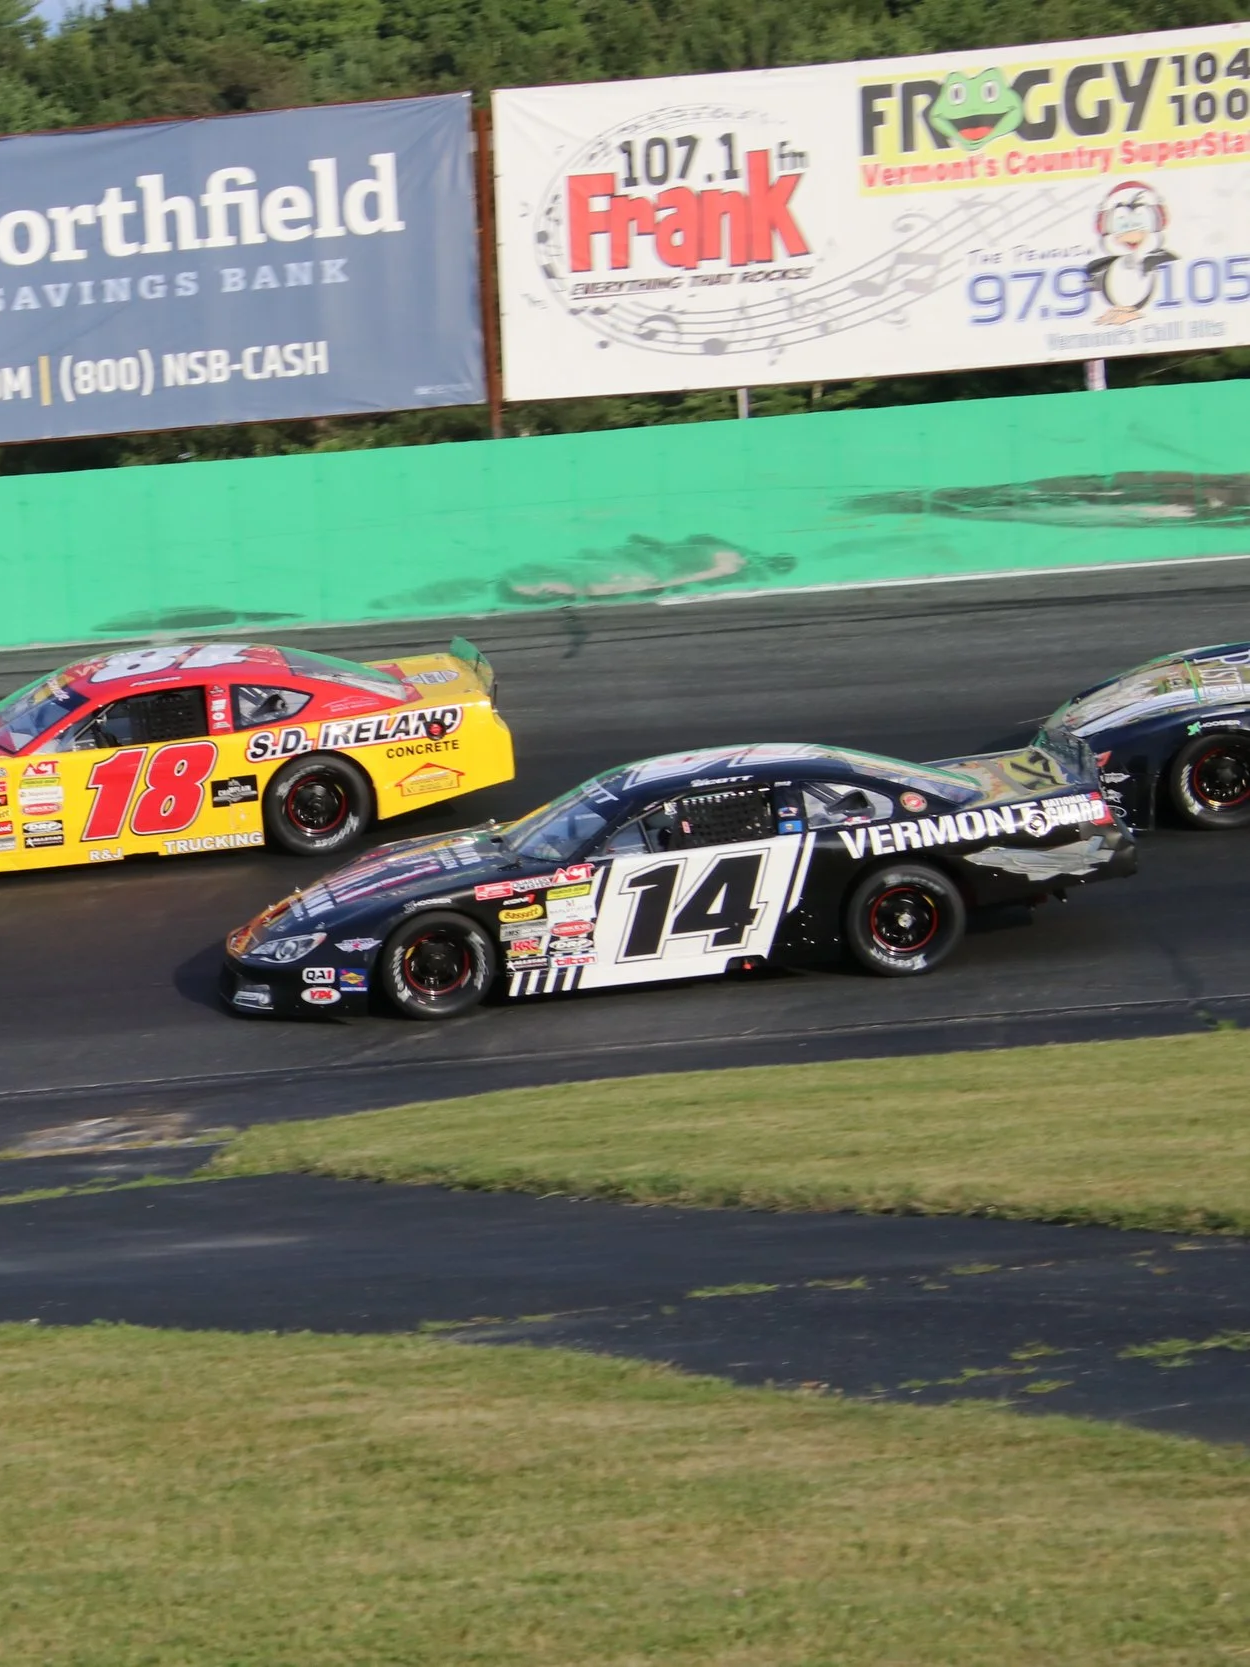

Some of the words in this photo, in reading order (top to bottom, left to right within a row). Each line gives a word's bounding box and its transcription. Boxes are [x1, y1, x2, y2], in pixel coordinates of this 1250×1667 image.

[860, 57, 1160, 156] FRGGY
[1169, 88, 1249, 127] 100
[619, 132, 742, 188] 107.1
[862, 154, 998, 188] Vermont's
[1004, 146, 1114, 174] Country
[1119, 130, 1250, 167] SuperSta
[567, 149, 813, 273] Frank
[221, 257, 351, 293] BANK
[570, 275, 683, 297] EVERYTHING
[689, 272, 733, 288] THAT
[967, 266, 1093, 327] 97.9
[59, 348, 152, 403] (800)
[162, 340, 328, 387] NSB-CASH
[248, 725, 315, 761] S.D.
[321, 706, 462, 751] IRELAND
[386, 739, 460, 759] CONCRETE
[22, 760, 59, 776] ACT
[81, 740, 218, 842] 18
[838, 801, 1039, 860] VERMONT
[1044, 800, 1106, 826] GUARD
[89, 848, 125, 862] R&J
[163, 830, 264, 856] TRUCKING
[552, 863, 595, 883] ACT
[615, 849, 770, 964] 14
[306, 970, 333, 981] QA1
